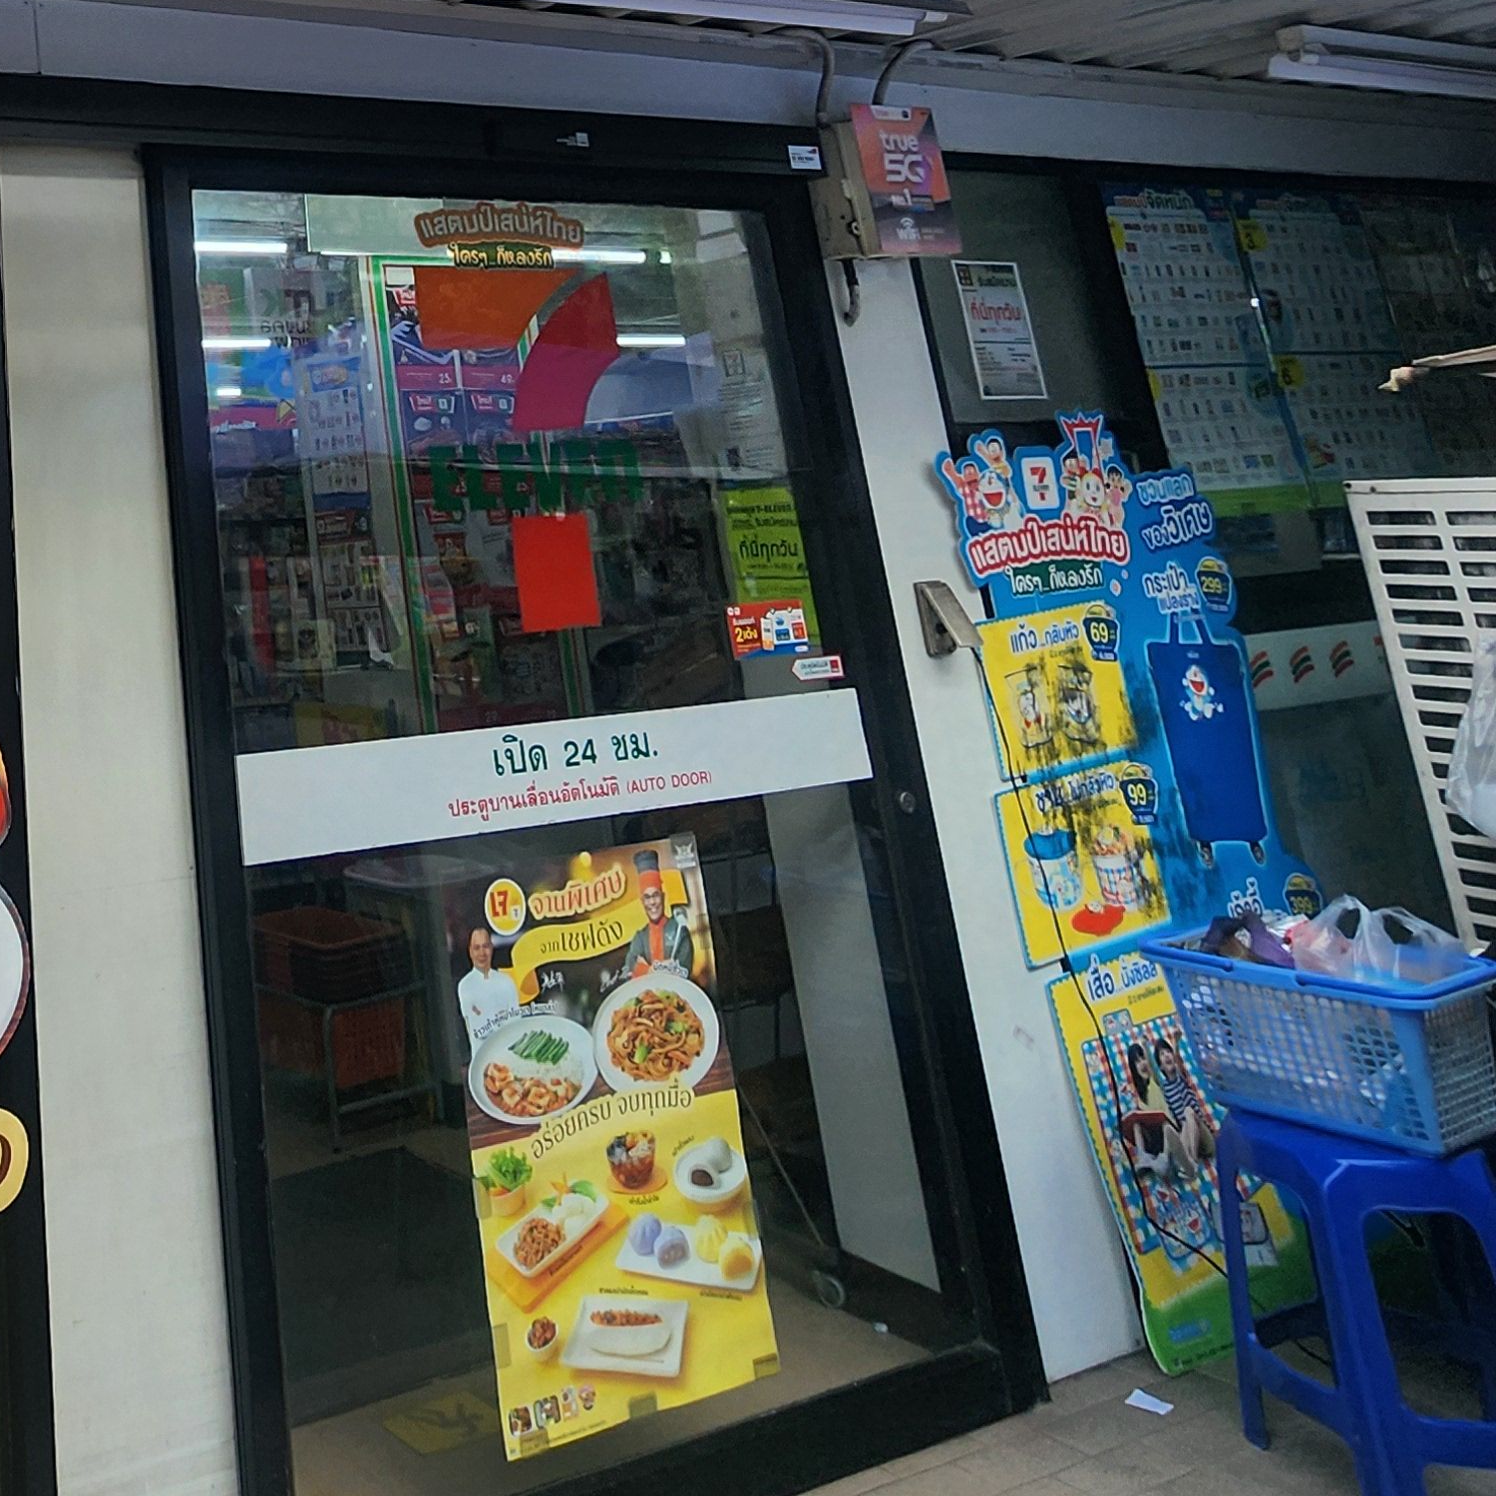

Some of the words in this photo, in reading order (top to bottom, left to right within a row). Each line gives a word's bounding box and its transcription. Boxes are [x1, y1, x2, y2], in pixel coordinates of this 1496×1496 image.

[880, 131, 919, 152] true
[885, 153, 924, 184] 5G
[971, 519, 1125, 570] แสตมป์เสน่ห์ไทย
[1143, 505, 1212, 548] ของวิเศษ
[1090, 622, 1109, 645] 69
[493, 734, 549, 777] เปิด
[563, 738, 598, 767] 24
[611, 731, 659, 762] ชม.
[448, 775, 621, 822] ประตูบานเลื่อนอัตโนมัติ
[626, 777, 666, 795] (AUTO
[672, 769, 713, 789] DOOR)
[1127, 783, 1147, 806] 99
[530, 1098, 613, 1160] อร่อยครบ
